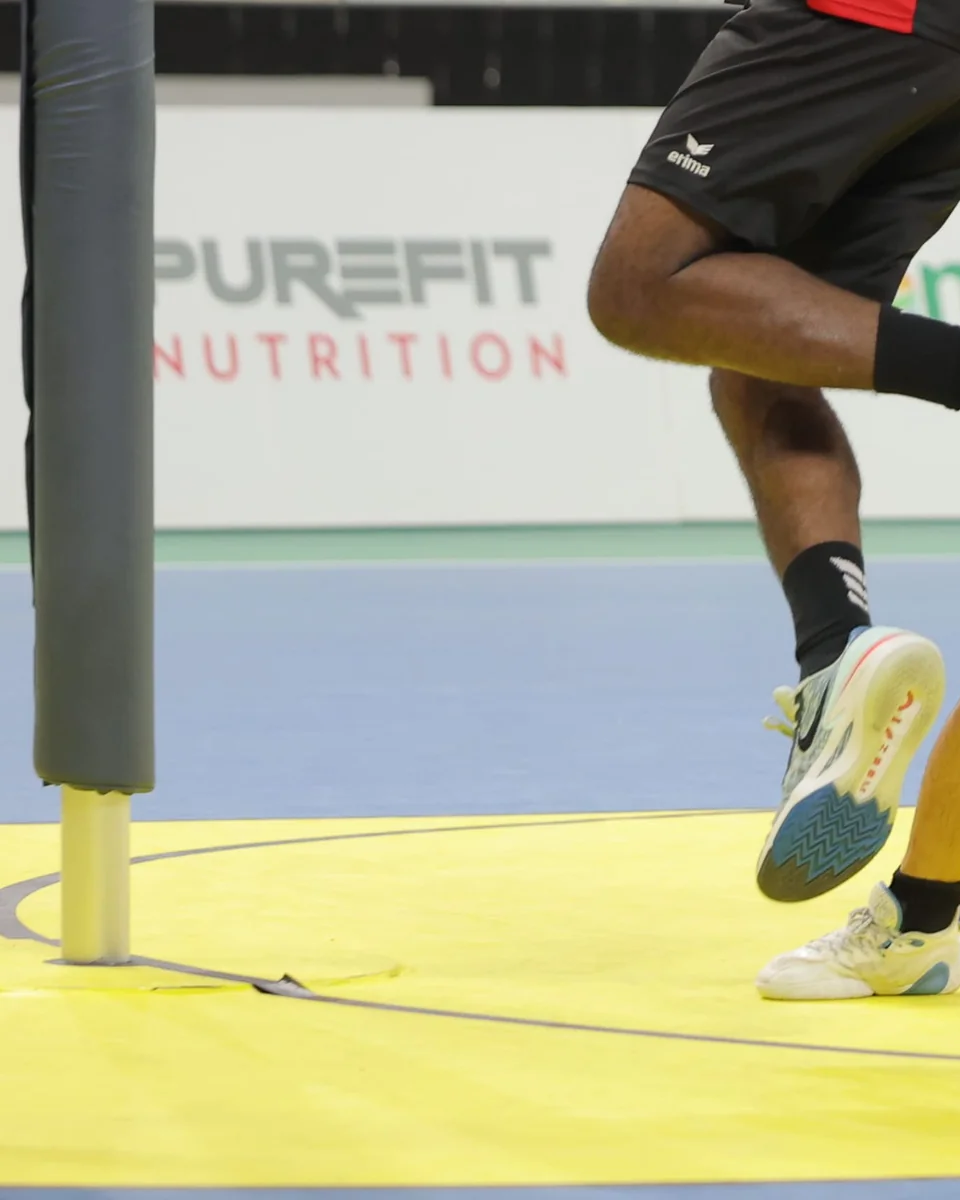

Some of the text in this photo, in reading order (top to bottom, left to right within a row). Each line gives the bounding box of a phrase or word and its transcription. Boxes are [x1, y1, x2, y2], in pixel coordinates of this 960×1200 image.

[667, 151, 711, 177] erima
[153, 238, 553, 319] PUREFIT
[153, 332, 569, 381] NUTRITION
